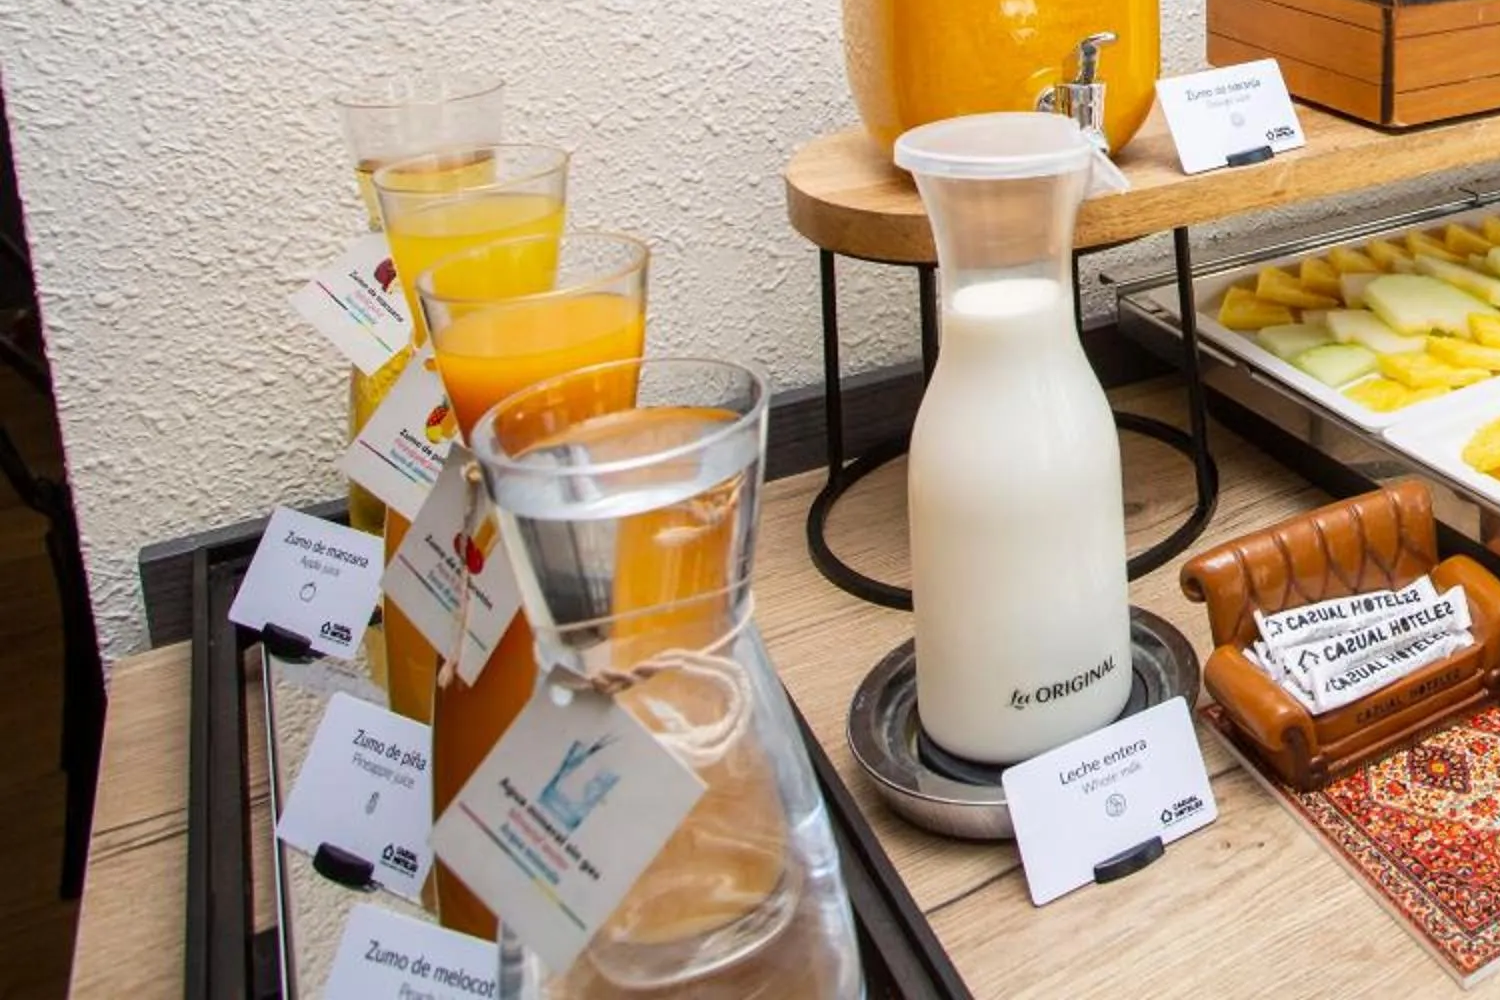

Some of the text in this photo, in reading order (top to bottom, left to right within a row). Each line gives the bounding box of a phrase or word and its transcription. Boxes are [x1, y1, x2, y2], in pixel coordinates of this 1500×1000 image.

[284, 531, 369, 568] Zumo de manzana
[1286, 588, 1422, 631] CASUAL HOTELES
[1323, 601, 1454, 662] CASUAL HOTELES
[1035, 654, 1117, 703] ORIGINAL
[1330, 661, 1389, 691] CASUAL
[353, 729, 428, 772] Zumo de piña
[1059, 739, 1147, 785] Leche entera
[499, 777, 527, 806] Agua
[526, 804, 568, 846] mineral
[364, 939, 410, 971] Zumo
[411, 954, 431, 979] de
